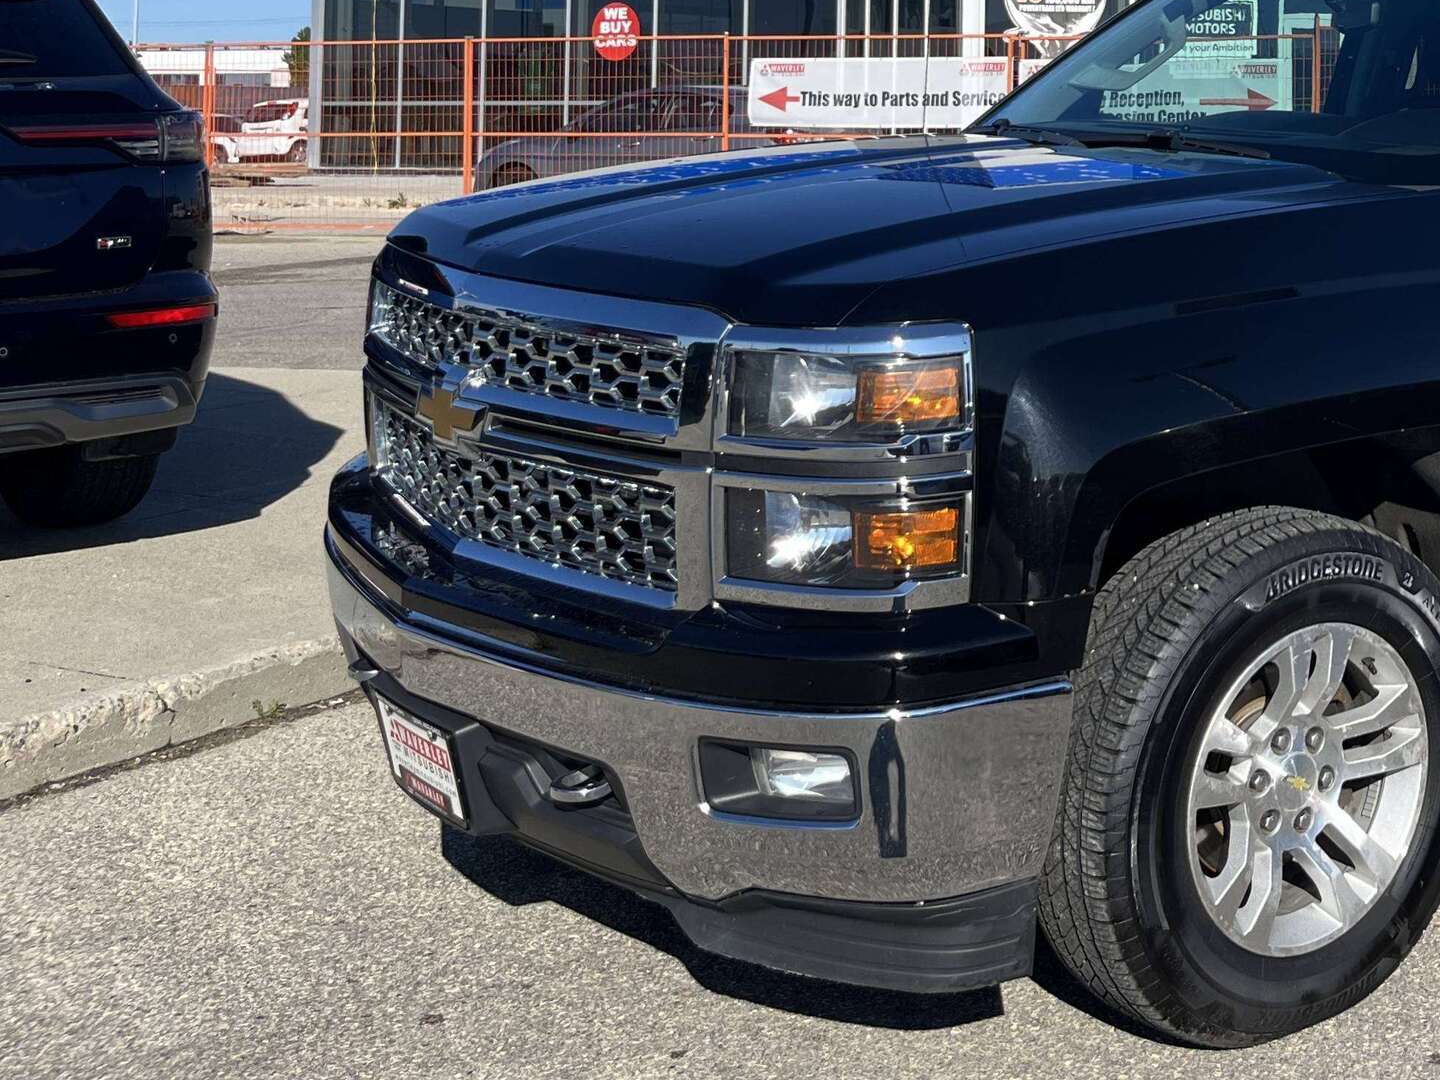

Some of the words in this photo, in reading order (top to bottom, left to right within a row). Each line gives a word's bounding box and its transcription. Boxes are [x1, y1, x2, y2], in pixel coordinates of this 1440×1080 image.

[603, 7, 628, 20] WE
[599, 21, 632, 33] BUY
[1185, 22, 1236, 34] MOTORS
[594, 35, 638, 48] CARS
[1212, 43, 1254, 52] Ambition
[800, 91, 830, 107] This
[833, 94, 861, 108] way
[864, 92, 878, 107] to
[881, 91, 919, 107] Parts
[922, 91, 949, 107] and
[1109, 89, 1184, 109] Reception,
[1264, 552, 1384, 603] BRIDGESTONE
[398, 722, 452, 772] WAVERLEY
